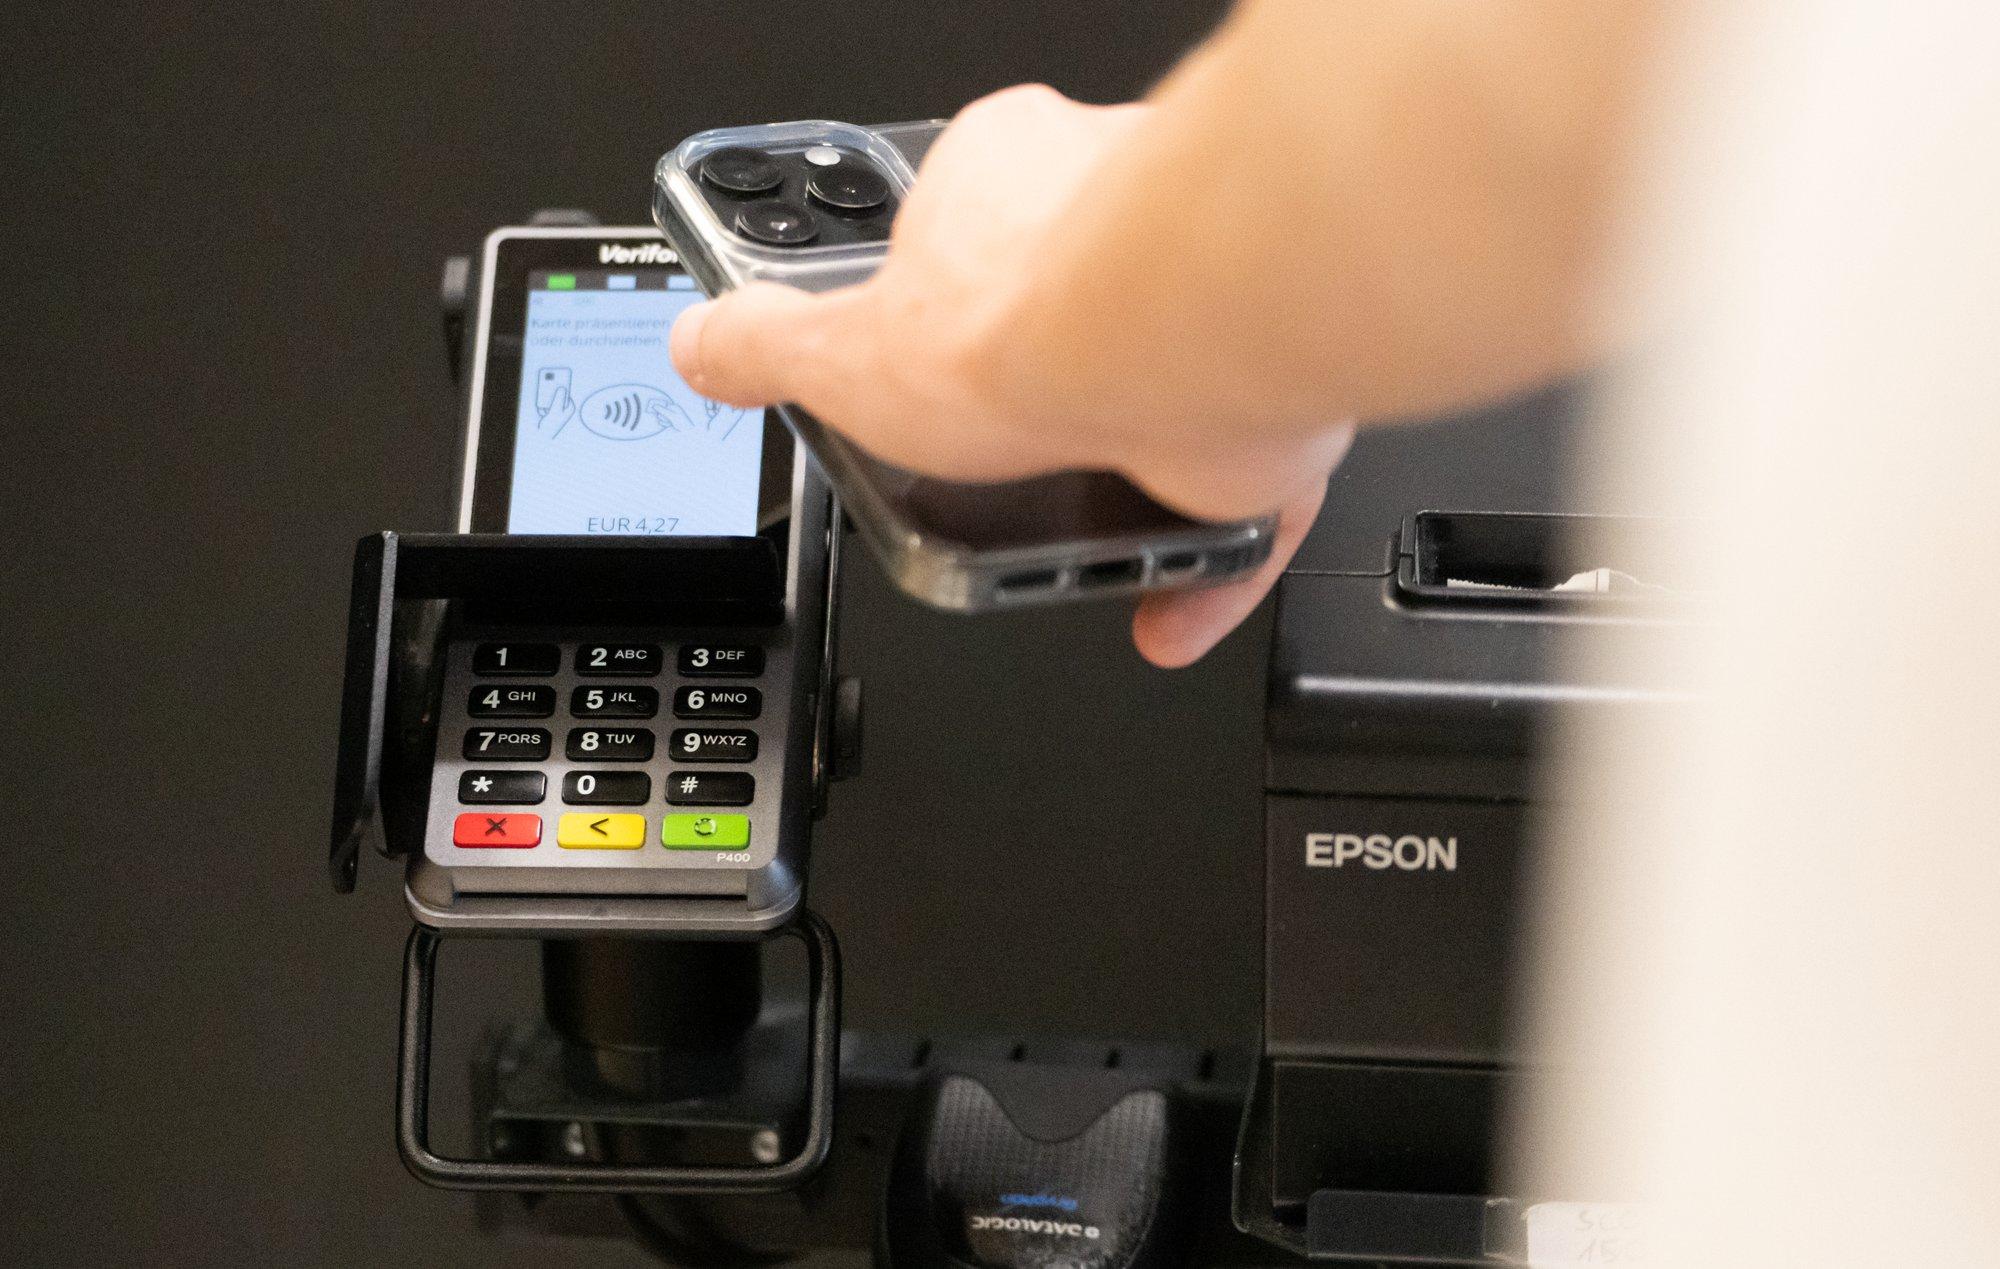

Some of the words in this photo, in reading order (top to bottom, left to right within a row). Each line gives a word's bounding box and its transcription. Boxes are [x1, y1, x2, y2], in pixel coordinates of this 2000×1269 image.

[531, 318, 571, 329] Karte
[574, 317, 670, 331] präsentieren
[530, 334, 563, 346] oder
[567, 334, 663, 346] durchziehen
[587, 517, 630, 532] EUR
[635, 517, 680, 534] 4,27
[496, 647, 508, 666] 1
[590, 647, 608, 666] 2
[614, 649, 648, 659] ABC
[691, 648, 710, 667] 3
[715, 650, 746, 660] DEF
[482, 689, 500, 708] 4
[508, 691, 536, 701] GHI
[586, 690, 604, 709] 5
[610, 692, 637, 702] JKL
[688, 690, 705, 709] 6
[711, 693, 748, 703] MNO
[479, 731, 496, 751] 7
[498, 733, 541, 744] PQRS
[580, 731, 599, 751] 8
[606, 733, 635, 744] TUV
[683, 732, 701, 752] 9
[703, 735, 748, 746] WXYZ
[577, 775, 596, 795] 0
[680, 776, 699, 793] #
[716, 853, 750, 863] P400
[1305, 833, 1457, 871] EPSON
[971, 1216, 1083, 1237] DATALOGIC
